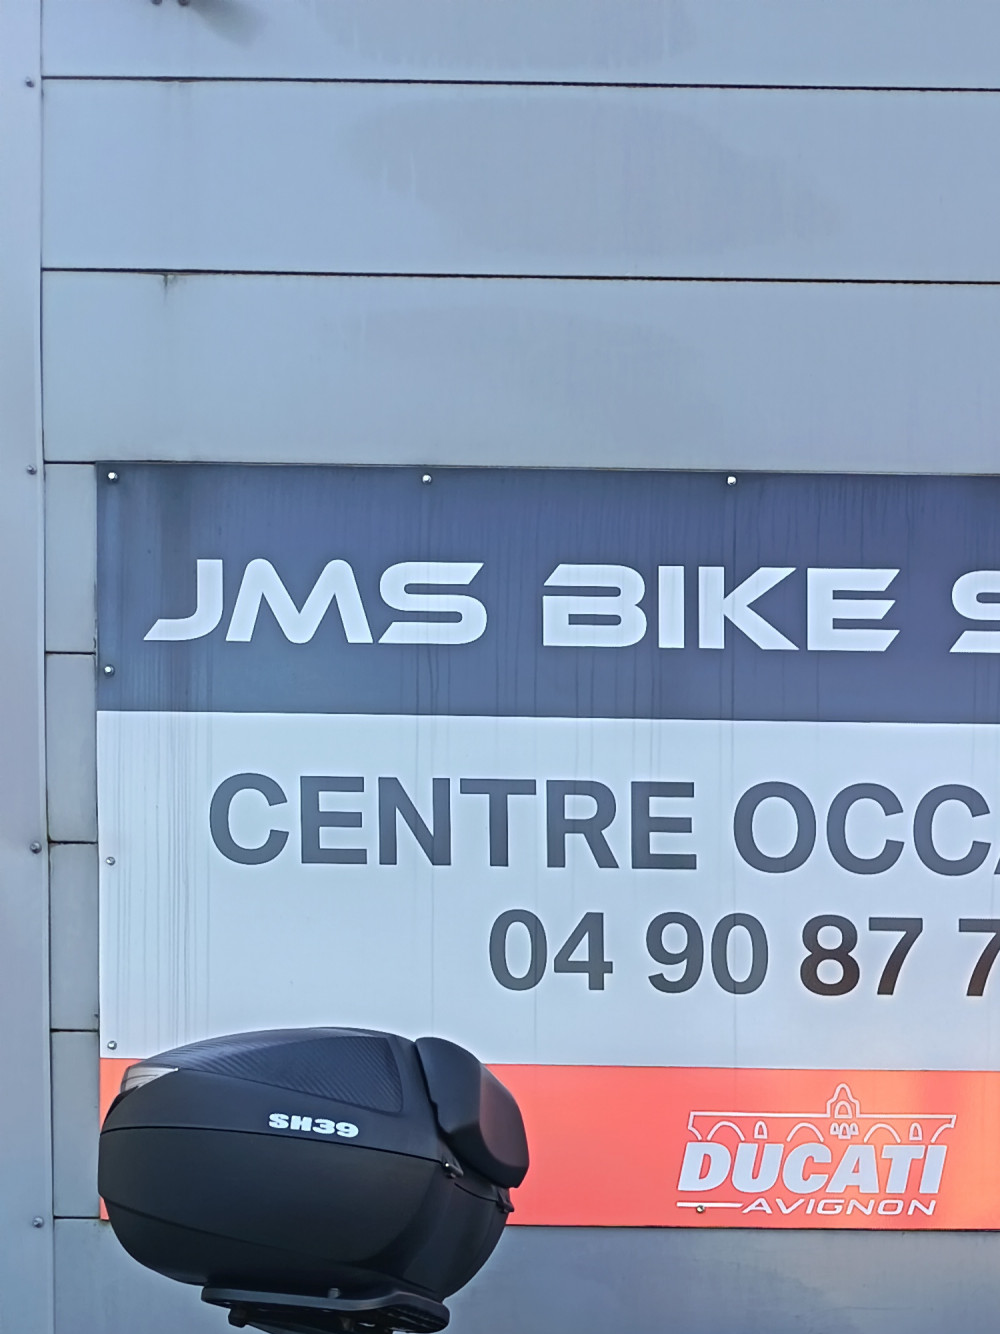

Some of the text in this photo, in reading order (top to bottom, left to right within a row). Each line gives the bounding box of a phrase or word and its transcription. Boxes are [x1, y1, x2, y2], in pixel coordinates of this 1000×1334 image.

[144, 559, 488, 645] JMS
[543, 564, 900, 652] BIKE
[209, 773, 697, 871] CENTRE
[489, 909, 614, 992] 04
[645, 911, 769, 995] 90
[800, 914, 924, 997] 87
[268, 1113, 359, 1138] SH39
[677, 1141, 948, 1195] DUCATI
[742, 1198, 936, 1216] AVIGNON
